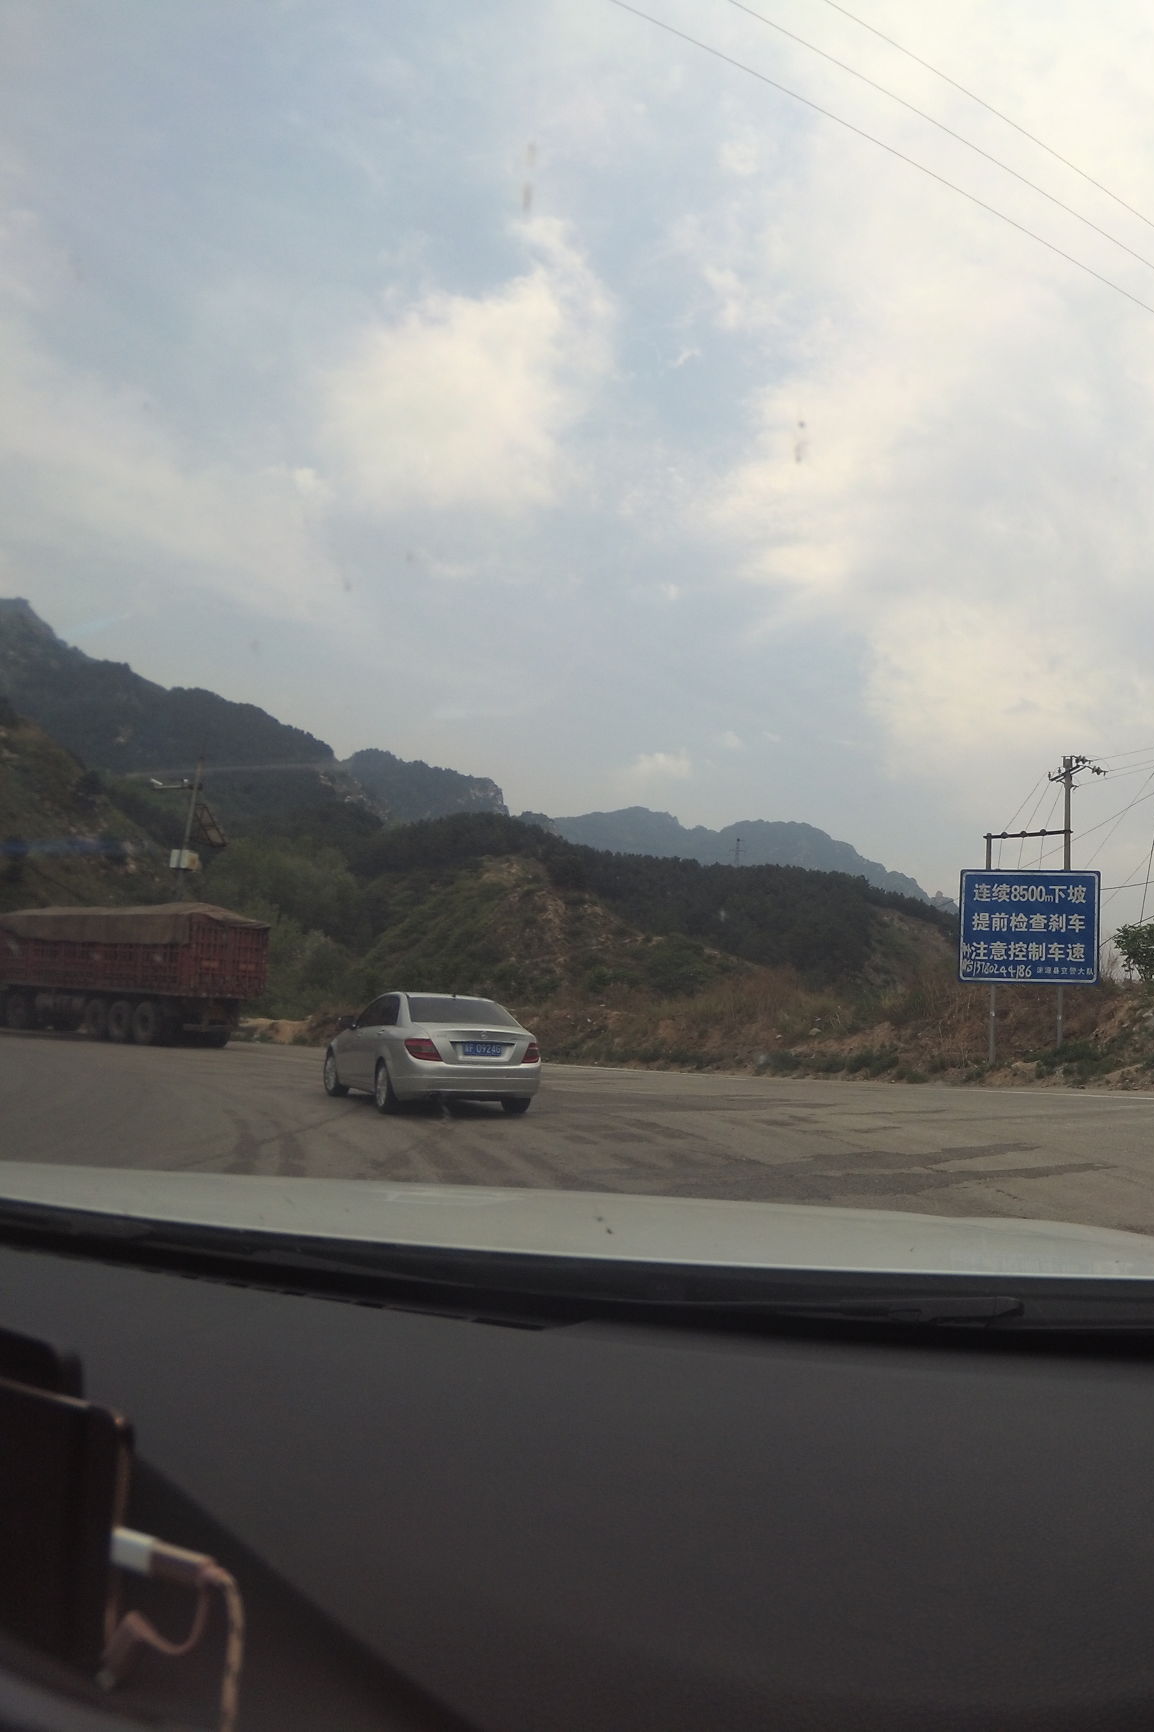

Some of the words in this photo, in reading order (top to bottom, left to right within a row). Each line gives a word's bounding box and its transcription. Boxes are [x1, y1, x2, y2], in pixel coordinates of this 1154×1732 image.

[973, 883, 1087, 904] 连续8500m下坡
[972, 912, 1086, 933] 提前检查刹车
[971, 941, 1086, 962] 注意控制车速
